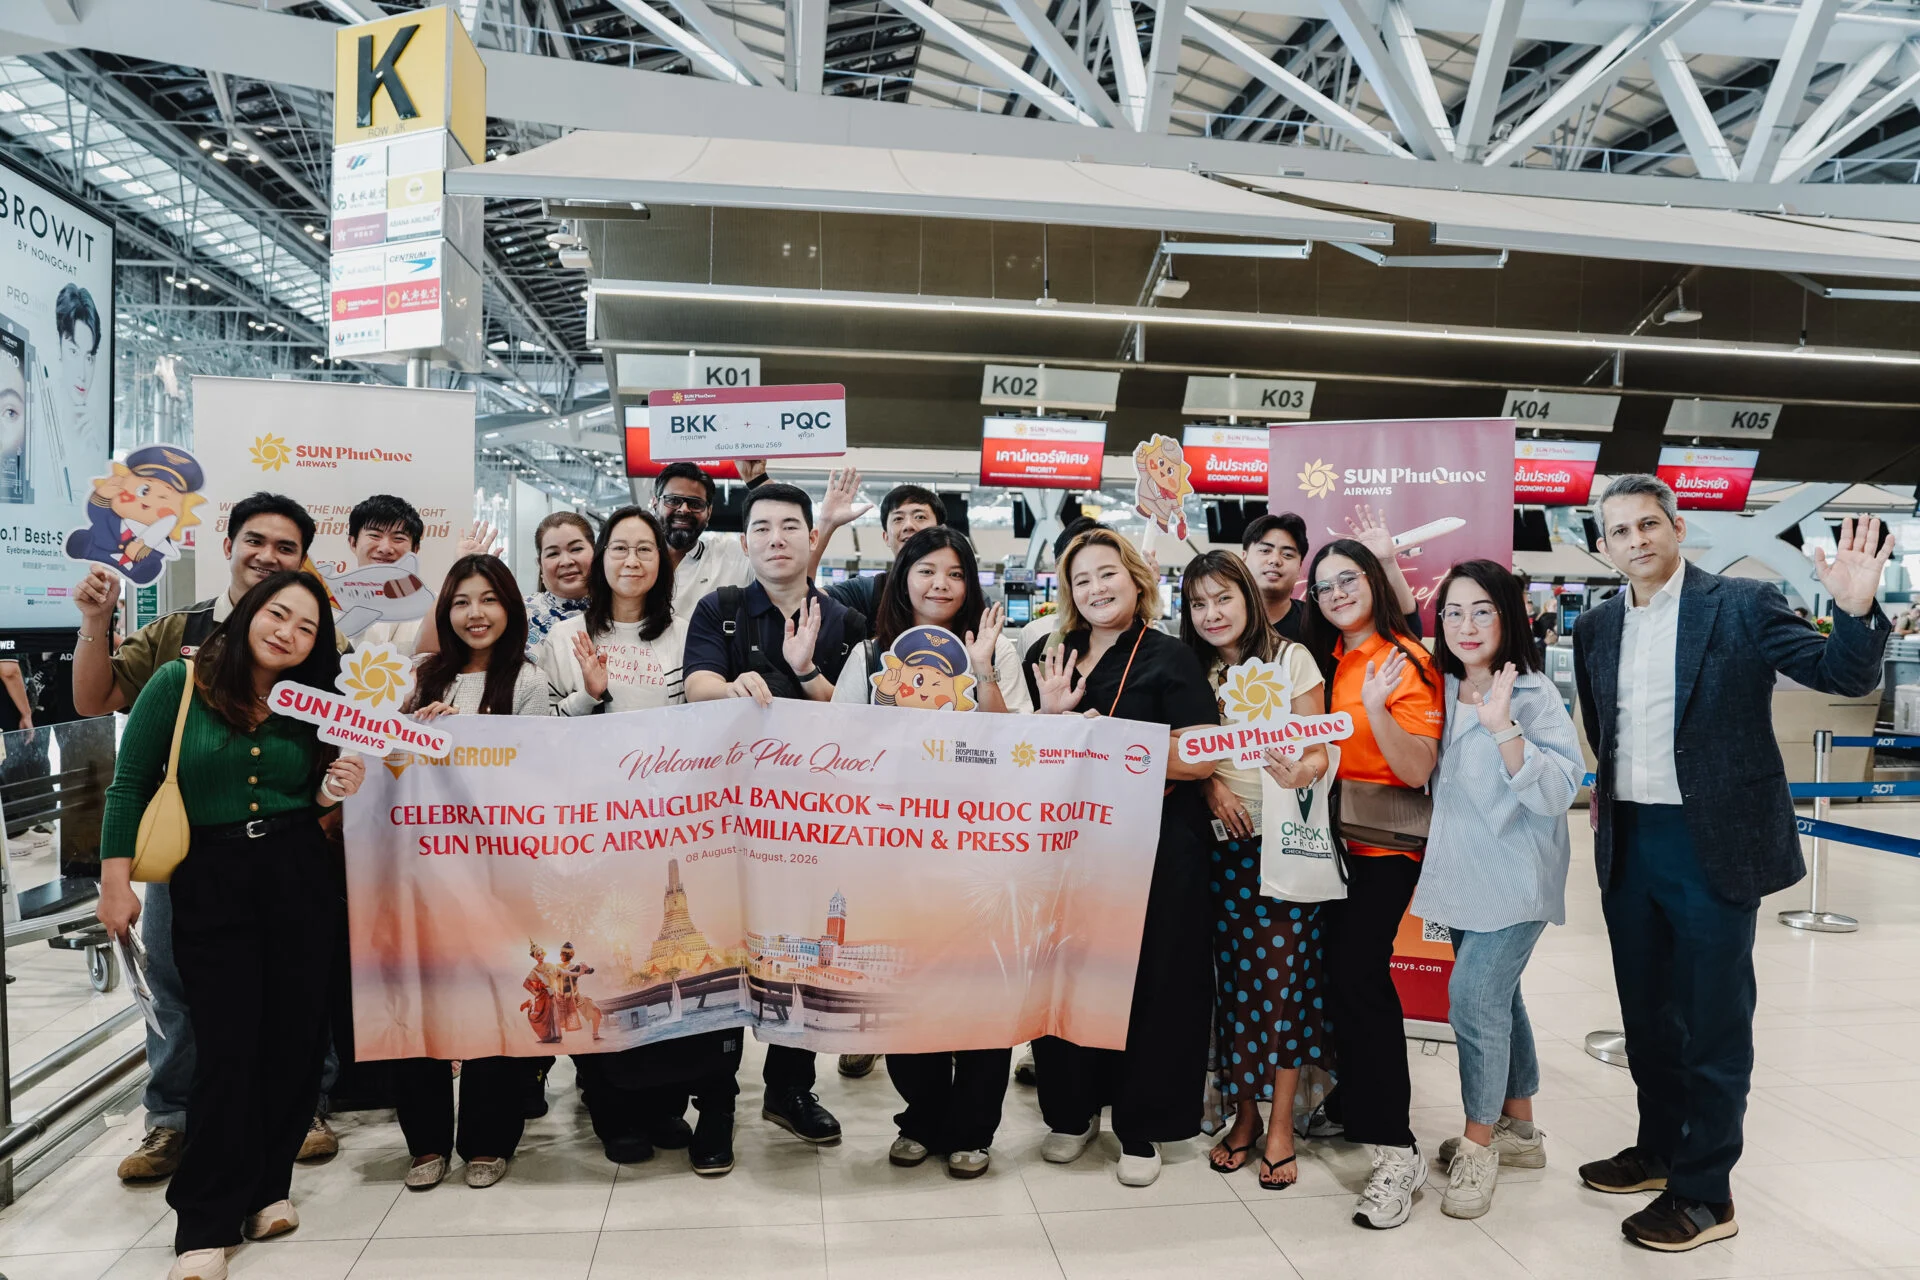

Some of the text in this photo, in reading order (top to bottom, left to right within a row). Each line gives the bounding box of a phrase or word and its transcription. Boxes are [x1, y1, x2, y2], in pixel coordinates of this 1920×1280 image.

[357, 24, 420, 128] K
[0, 186, 94, 263] BROWIT
[17, 239, 78, 277] BY NONGCHAT
[389, 251, 427, 264] CENTRUM
[706, 366, 751, 386] K01
[991, 375, 1038, 396] K02
[1260, 388, 1304, 409] K03
[1510, 399, 1550, 420] K04
[670, 411, 832, 434] BKK PQC
[1731, 411, 1771, 430] K05
[765, 441, 783, 449] 2569
[296, 445, 413, 463] SUN PhuQuoc
[296, 460, 338, 469] AIRWAYS
[1025, 466, 1057, 474] PRIORITY
[1207, 473, 1263, 483] ECONOMY CLASS
[1344, 466, 1487, 485] SUN PhuQuoc
[1343, 486, 1393, 496] AIRWAYS
[1546, 485, 1565, 493] CLASS
[306, 504, 330, 514] THE
[418, 507, 446, 518] IGHT
[0, 526, 63, 545] o.1 Best-S
[6, 545, 31, 555] Eyebrow
[32, 547, 52, 557] Product
[0, 640, 15, 650] WER
[595, 644, 651, 657] RTING THE
[60, 653, 73, 661] AD
[608, 655, 639, 672] FUSED
[609, 672, 665, 686] OMMITTED
[276, 688, 445, 750] SUN PhuQuoc
[326, 726, 386, 750] AIRWAYS
[955, 740, 967, 748] SUN
[1186, 719, 1345, 757] SUN PhuQuoc
[1876, 738, 1896, 746] AOT
[453, 746, 517, 767] GROUP
[618, 738, 887, 781] Welcome to Phu Quoc!
[955, 748, 989, 757] HOSPITALITY
[955, 755, 998, 765] ENTERTAINMENT
[1039, 748, 1110, 761] SUN PhuQuoc
[1870, 783, 1896, 794] AOT
[390, 804, 546, 826] CELEBRATING
[553, 802, 599, 824] THE
[606, 785, 744, 821] INAUGURAL
[750, 786, 873, 816] BANGKOK
[899, 797, 950, 819] PHU
[957, 800, 1032, 825] QUOC
[1040, 800, 1114, 825] ROUTE
[1281, 821, 1325, 842] CHECK
[1797, 819, 1816, 833] OT
[418, 814, 1079, 860] SUN PHUQUOC AIRWAYS FAMILIARIZATION & PRESS TRIP
[685, 852, 699, 864] 08
[701, 846, 737, 860] August
[749, 849, 787, 863] August,
[790, 853, 818, 865] 2026
[1389, 962, 1442, 973] ways.com
